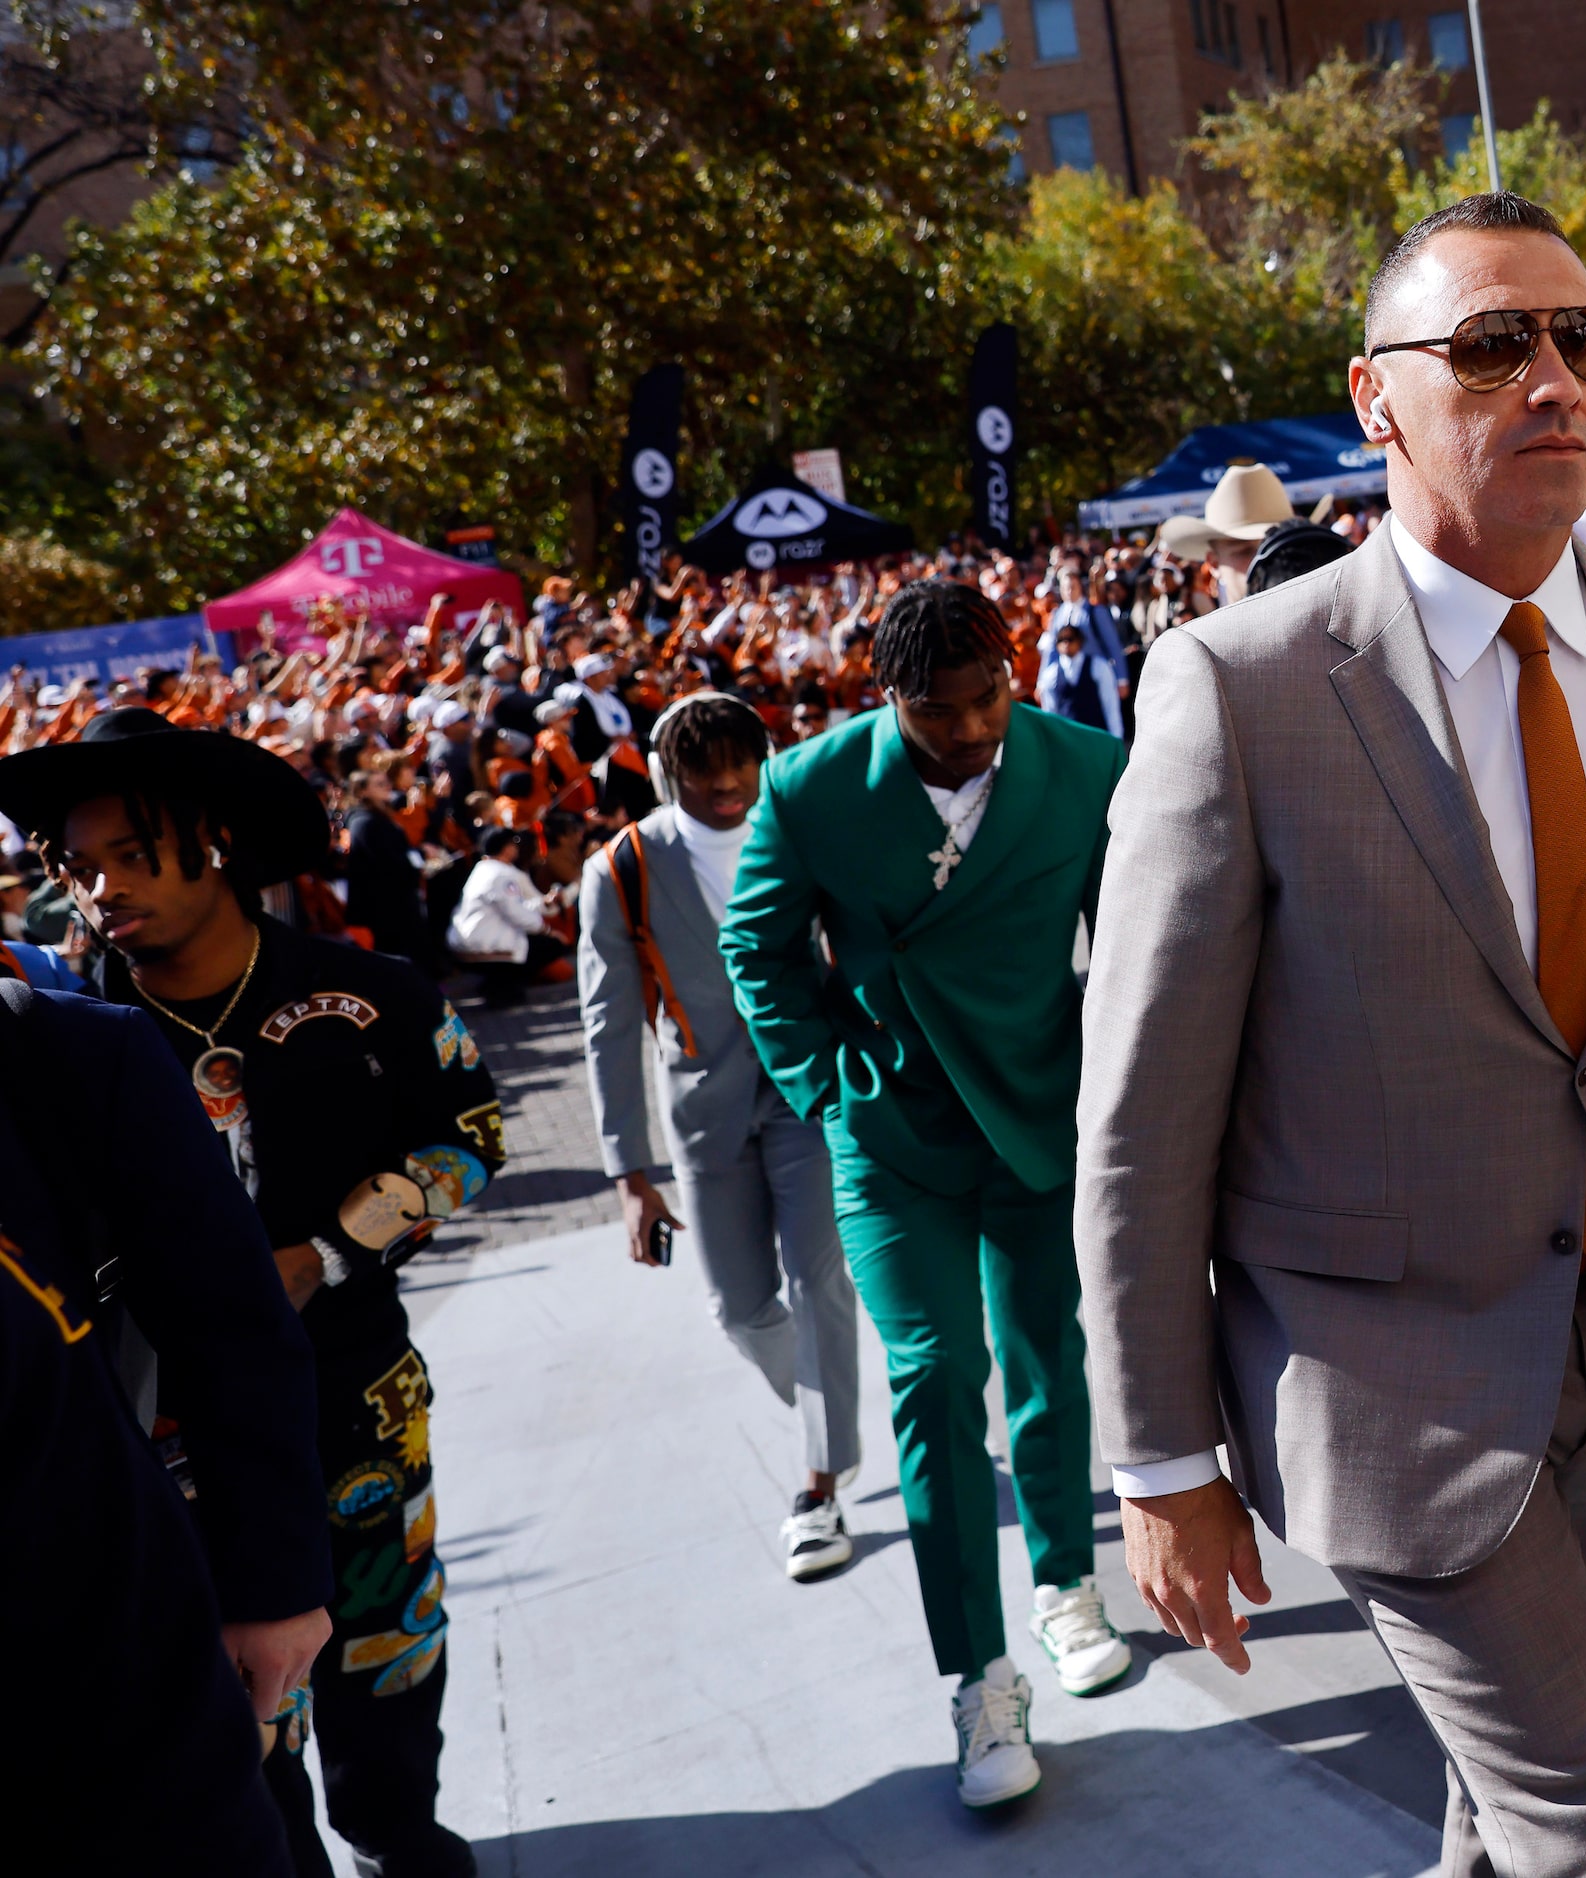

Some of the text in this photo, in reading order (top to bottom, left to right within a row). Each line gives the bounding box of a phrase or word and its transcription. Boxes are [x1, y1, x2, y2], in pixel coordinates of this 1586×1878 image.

[988, 461, 1008, 539] razr
[779, 538, 825, 559] razr
[275, 998, 361, 1028] EPTM
